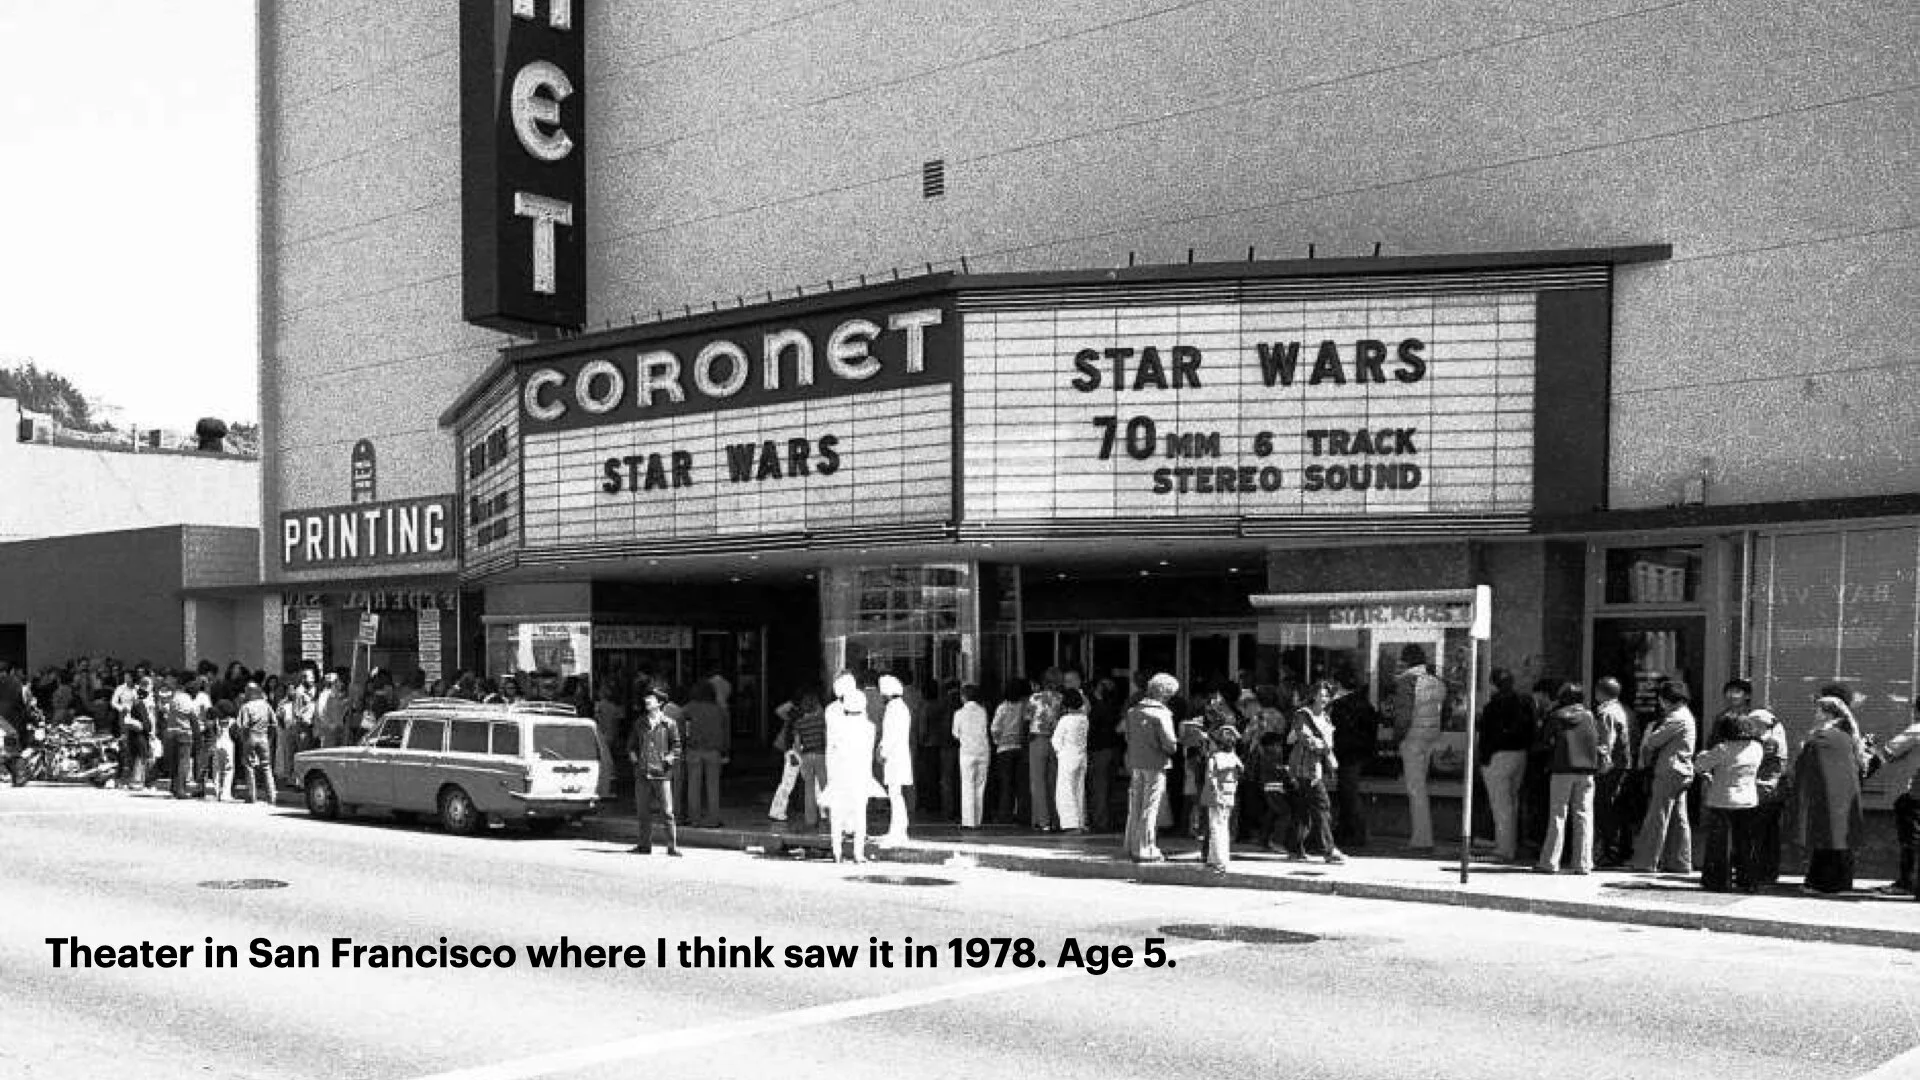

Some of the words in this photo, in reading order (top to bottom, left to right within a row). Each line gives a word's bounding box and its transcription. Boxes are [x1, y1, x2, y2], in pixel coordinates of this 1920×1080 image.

[511, 0, 574, 294] ET
[524, 308, 943, 421] CORONET
[1072, 346, 1202, 392] STAR
[1258, 338, 1427, 387] WARS
[602, 450, 694, 494] STAR
[726, 434, 841, 483] WARS
[1254, 431, 1273, 457] 6
[1306, 427, 1418, 457] TRACK
[1153, 464, 1282, 494] STEREO
[1304, 463, 1422, 492] SOUND
[284, 504, 445, 563] PRINTING
